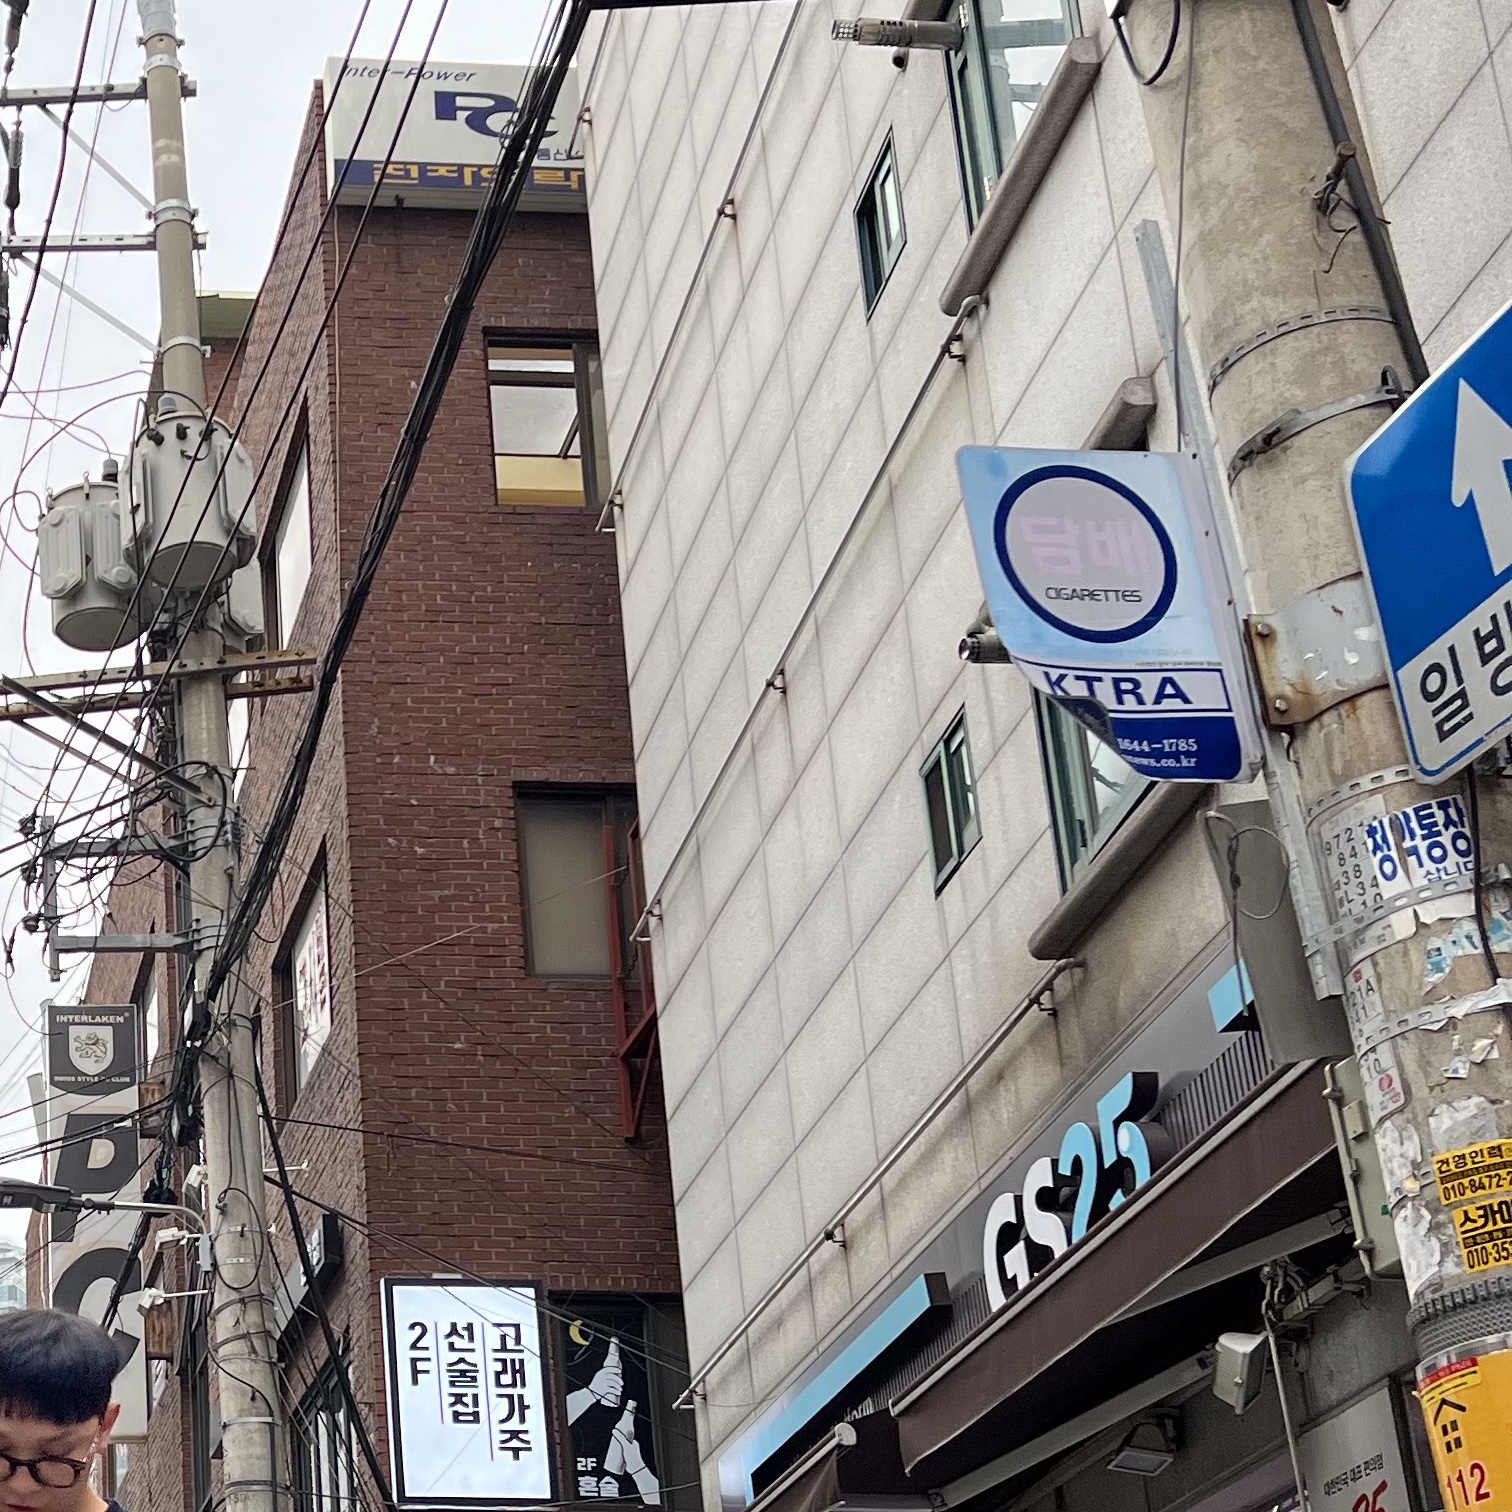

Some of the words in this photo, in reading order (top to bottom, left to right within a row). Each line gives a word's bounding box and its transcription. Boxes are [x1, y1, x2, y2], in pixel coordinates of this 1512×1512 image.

[1019, 514, 1149, 577] 담배
[1045, 586, 1143, 603] CIGARETTES
[56, 1014, 124, 1024] INTERLAKEN
[1436, 1144, 1504, 1174] 건영인력
[983, 1071, 1152, 1312] GS25
[407, 1321, 431, 1386] 2F
[444, 1321, 481, 1425] 선술집
[491, 1322, 533, 1462] 고래가주
[579, 1475, 620, 1498] 혼술
[1364, 1451, 1385, 1478] 편의점
[1445, 1462, 1491, 1512] 112
